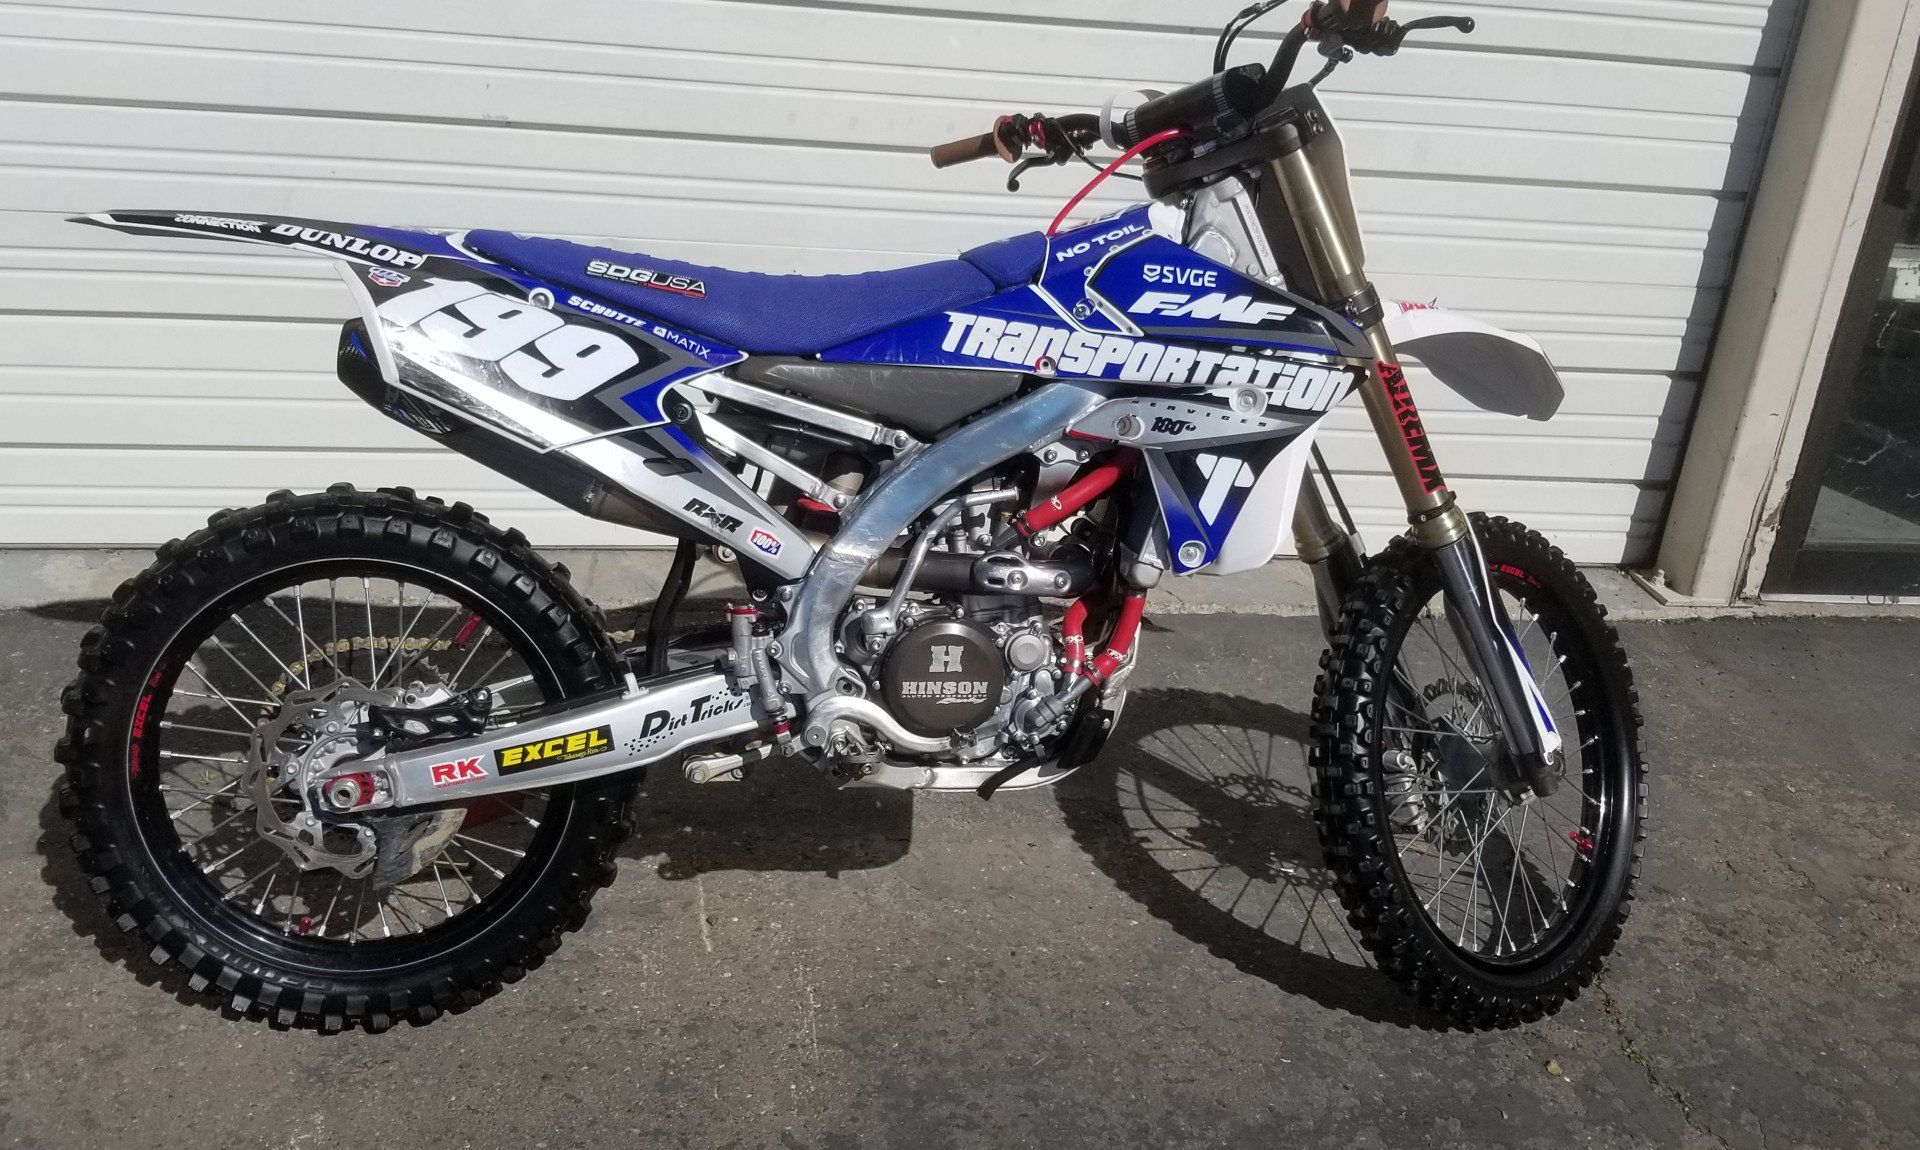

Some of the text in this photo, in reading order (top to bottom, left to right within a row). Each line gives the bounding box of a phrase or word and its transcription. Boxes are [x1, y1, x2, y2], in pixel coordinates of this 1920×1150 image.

[271, 223, 421, 269] DUNLOP
[1056, 224, 1145, 262] NO TOIL
[568, 295, 647, 328] SCHUTTE
[1127, 292, 1297, 324] FMF
[377, 278, 640, 401] 199
[666, 331, 711, 359] MATIX
[752, 531, 782, 556] 100%
[929, 646, 964, 672] H
[902, 681, 989, 695] HINSON
[639, 695, 743, 740] Dirt Tricks
[500, 730, 608, 767] EXCEL
[431, 757, 485, 783] RK
